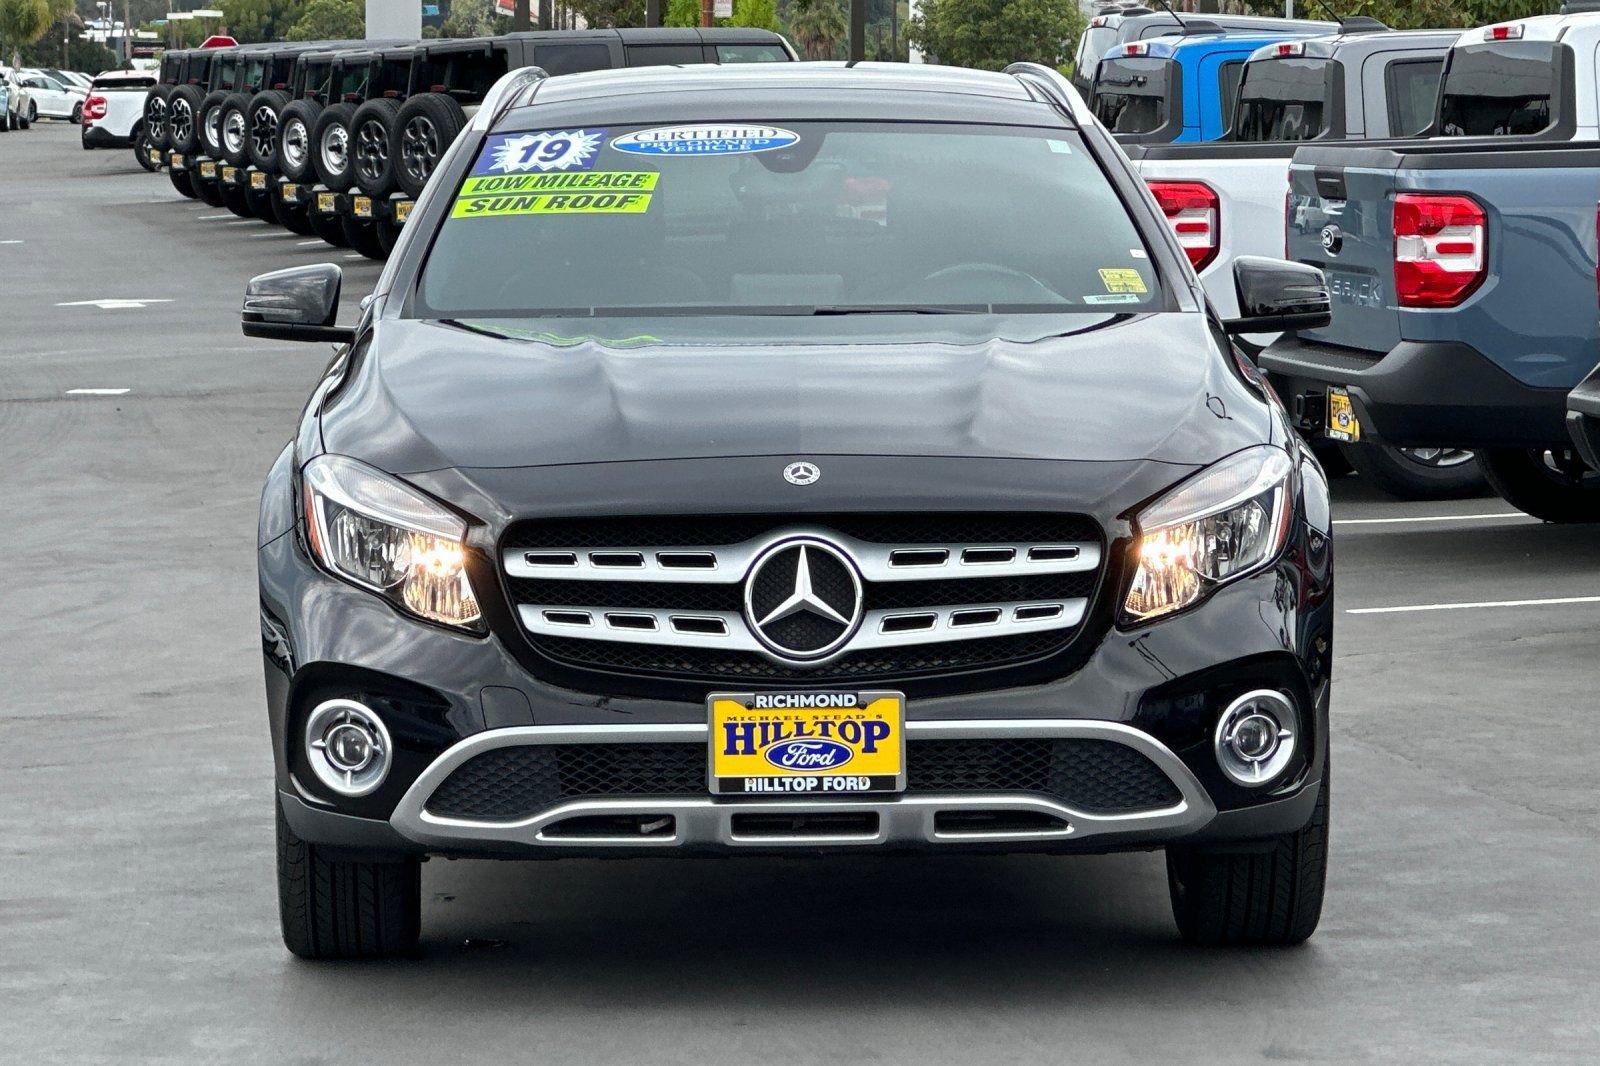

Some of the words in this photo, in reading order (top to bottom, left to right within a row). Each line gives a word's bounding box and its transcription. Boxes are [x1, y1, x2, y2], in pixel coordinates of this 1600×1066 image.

[633, 128, 778, 141] CERTIFIED
[518, 138, 572, 164] 19
[639, 139, 770, 149] PRE-OWNED
[660, 143, 751, 153] VEHICLE
[472, 176, 531, 192] LOW
[533, 173, 649, 189] MILEAGE
[465, 196, 536, 213] SUN
[544, 194, 640, 210] ROOF
[755, 694, 857, 708] RICHMOND
[812, 713, 884, 721] STEAD'S
[723, 720, 891, 755] HILLTOP
[782, 743, 836, 766] Ford
[744, 777, 818, 792] HILLTOP
[823, 776, 870, 791] FORD
